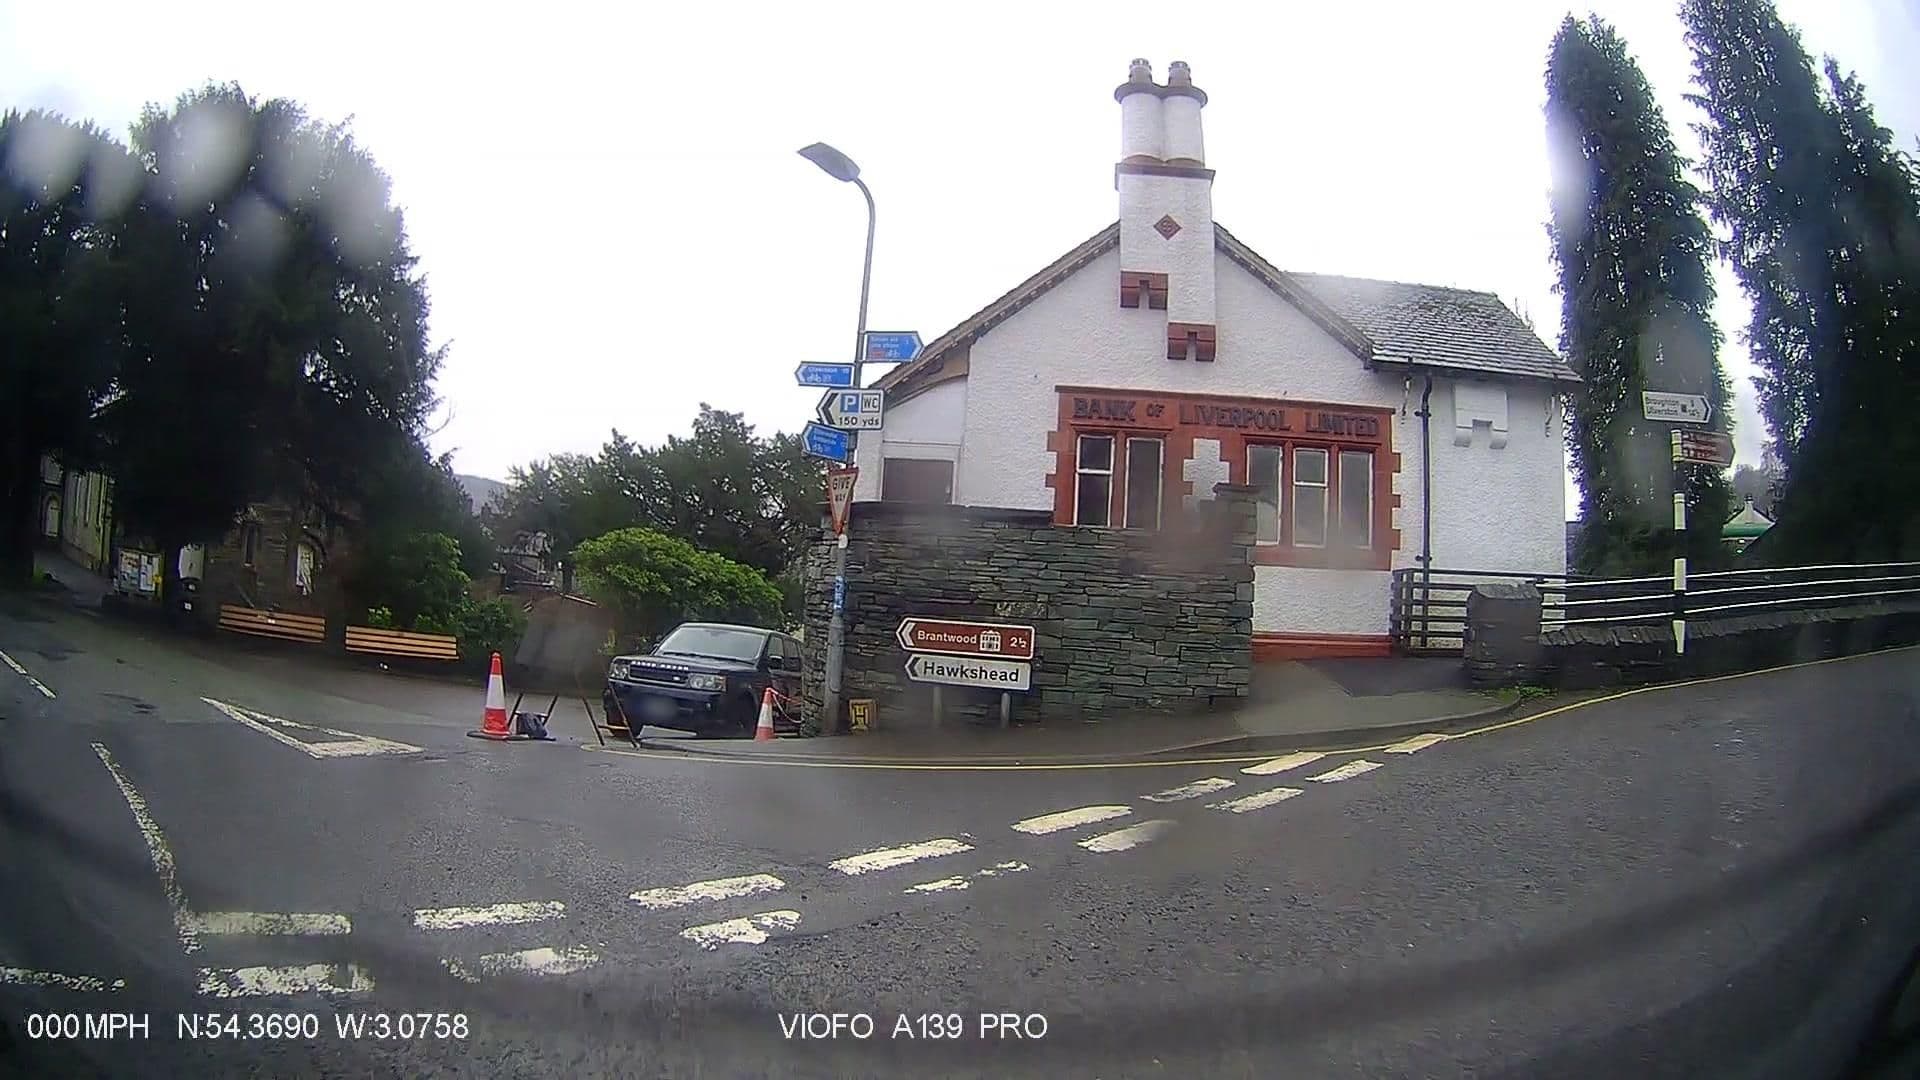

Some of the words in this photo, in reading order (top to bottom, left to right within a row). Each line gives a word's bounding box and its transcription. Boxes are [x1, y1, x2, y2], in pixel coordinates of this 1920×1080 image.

[844, 395, 856, 411] P
[863, 397, 879, 409] WC
[839, 416, 858, 426] 150
[862, 416, 880, 427] yds
[1073, 397, 1137, 422] BANK
[1147, 403, 1165, 418] OF
[1179, 401, 1294, 431] LIVERPOOL
[1304, 410, 1379, 437] LIMITED
[833, 476, 851, 490] GIVE
[917, 629, 977, 645] Brantwood
[923, 660, 1019, 683] Hawkshead
